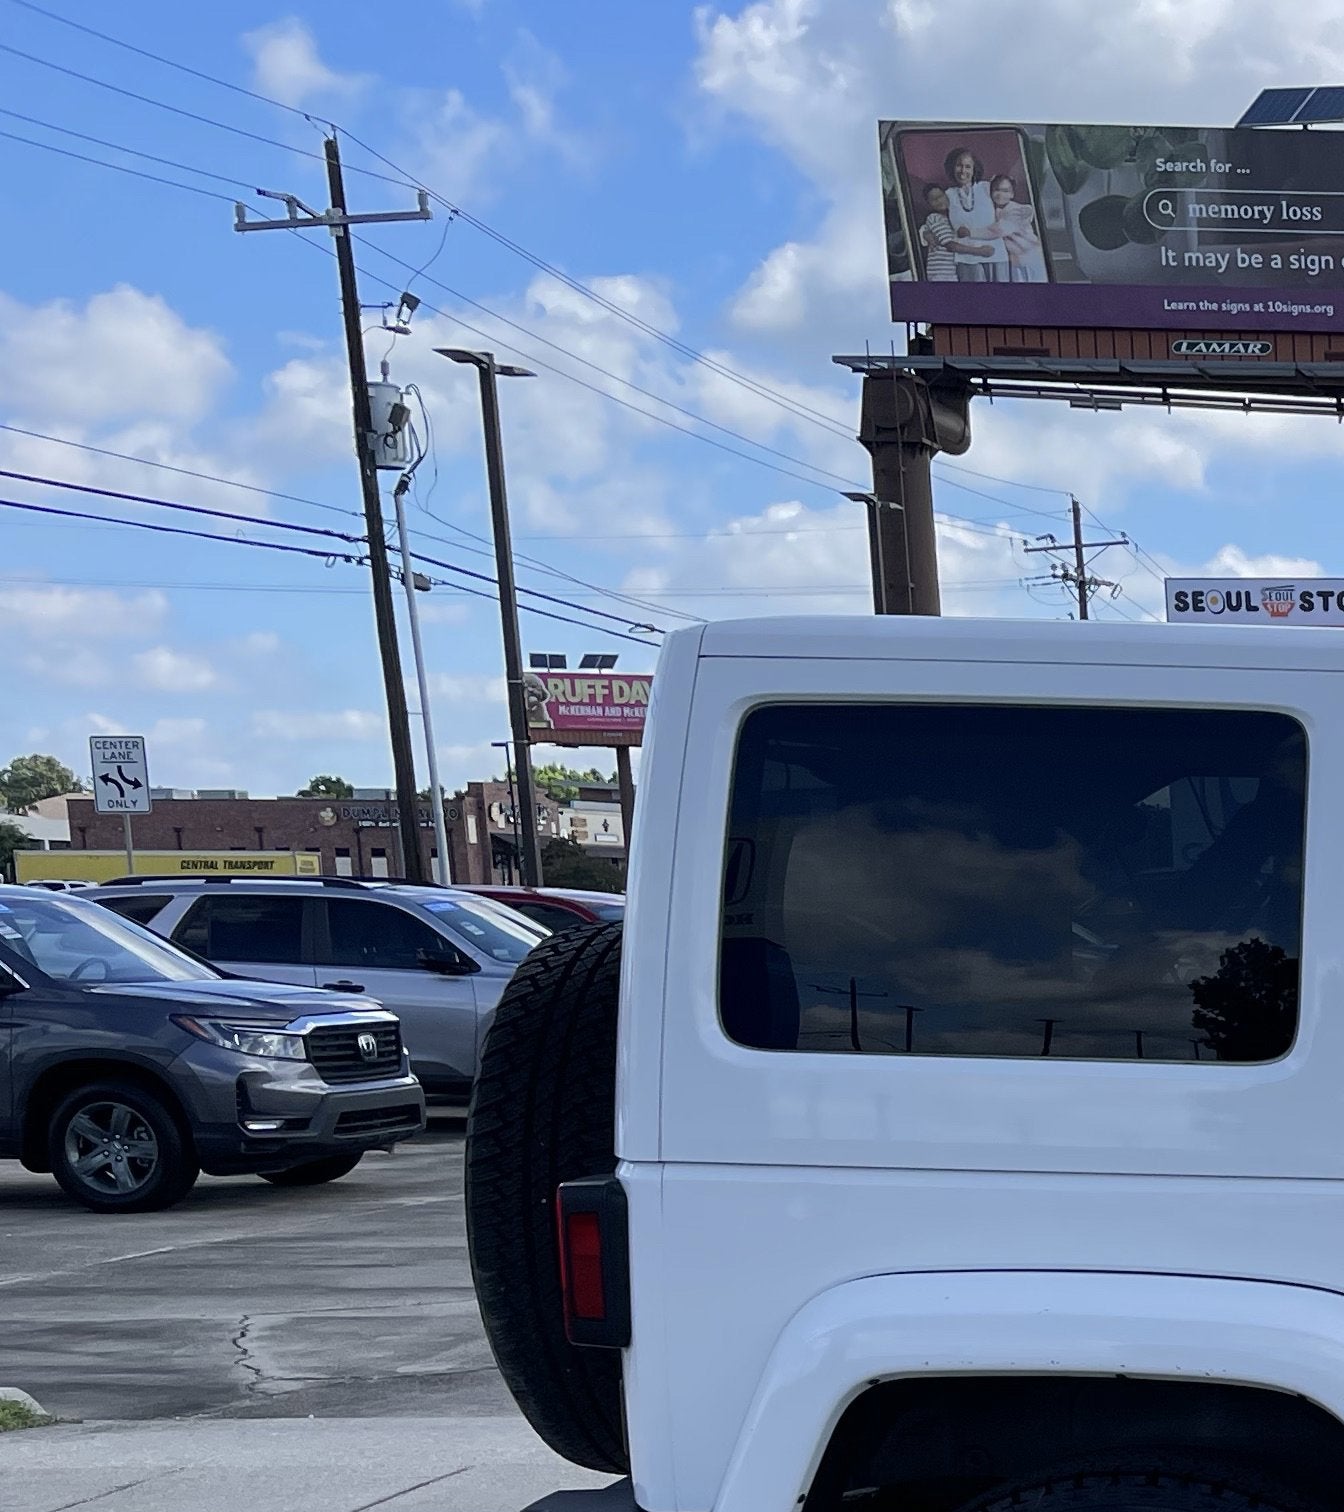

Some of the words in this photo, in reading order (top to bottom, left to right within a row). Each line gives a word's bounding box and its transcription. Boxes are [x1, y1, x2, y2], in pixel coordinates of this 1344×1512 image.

[1156, 158, 1206, 173] Search
[1210, 159, 1232, 173] for
[1188, 202, 1275, 225] memory
[1281, 200, 1323, 222] loss
[1161, 246, 1177, 266] It
[1184, 250, 1230, 273] may
[1237, 248, 1263, 269] be
[1270, 254, 1282, 270] a
[1289, 248, 1335, 275] sign
[1164, 299, 1197, 311] Learn
[1199, 300, 1218, 311] the
[1221, 300, 1250, 314] signs
[1253, 302, 1265, 312] at
[1268, 301, 1334, 316] 10signs.org
[1180, 342, 1263, 354] LAMAR
[1174, 589, 1260, 614] SEOUL
[1266, 602, 1292, 614] STOP
[547, 678, 609, 703] RUFF
[604, 706, 621, 717] AND
[623, 706, 648, 718] McKE
[94, 740, 140, 750] CENTER
[102, 751, 134, 761] LANE
[107, 799, 138, 809] ONLY
[341, 807, 400, 819] DUMPLIN
[180, 860, 219, 870] CENTRAL
[223, 860, 275, 870] TRANSPORT
